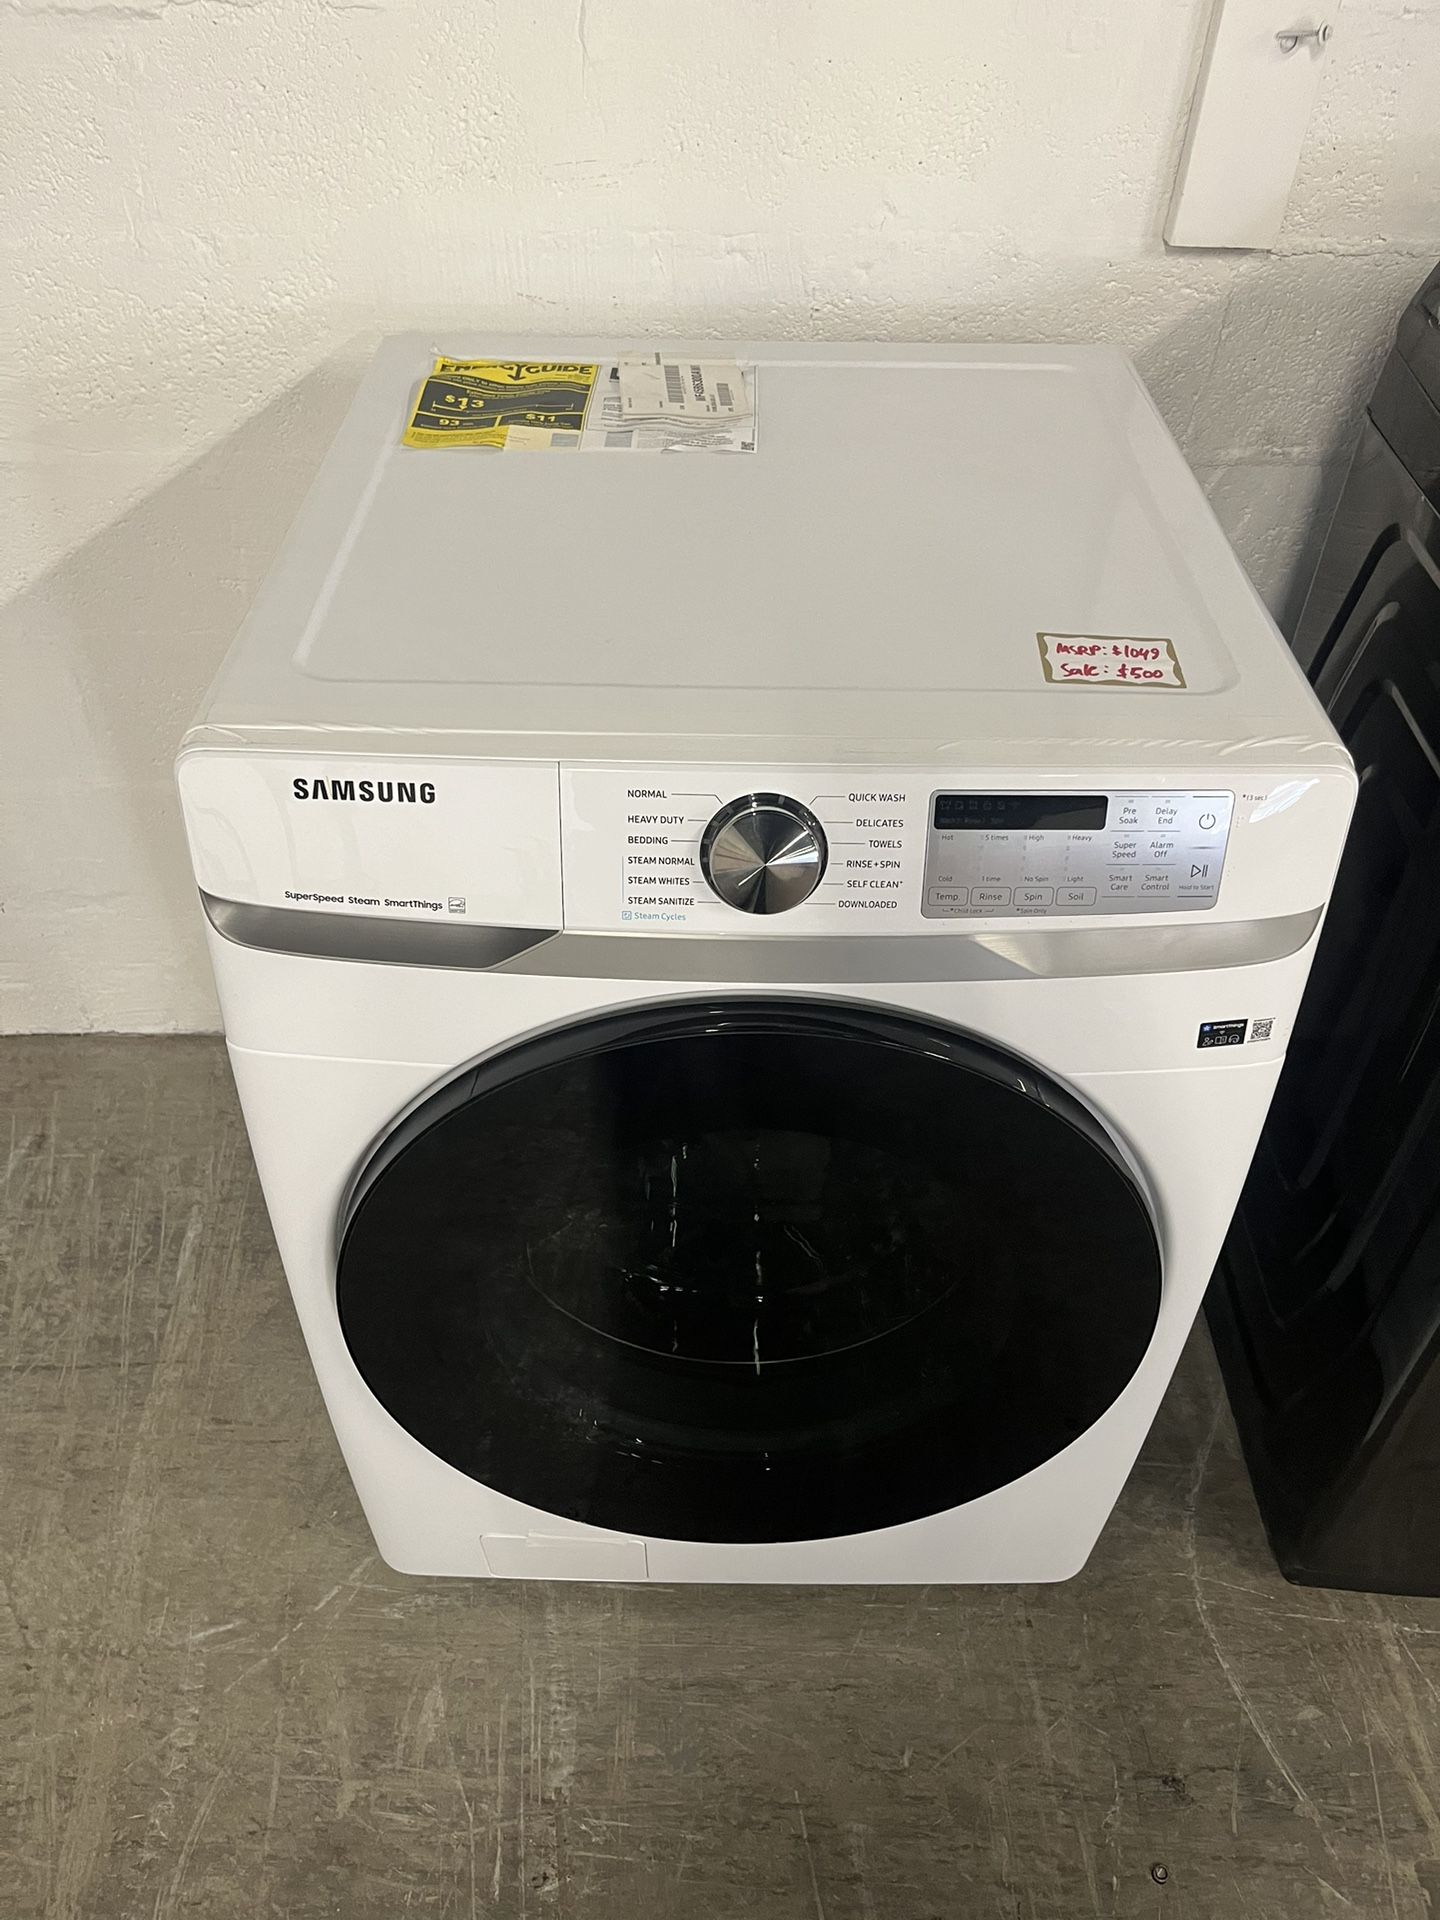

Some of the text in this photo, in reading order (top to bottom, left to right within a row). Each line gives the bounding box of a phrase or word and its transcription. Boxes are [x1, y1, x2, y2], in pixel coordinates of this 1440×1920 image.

[444, 395, 485, 411] $13
[439, 418, 460, 426] 93
[525, 413, 555, 422] $11
[1056, 643, 1160, 661] MSRP: $1049
[1116, 663, 1164, 679] $500
[293, 778, 436, 804] SAMSUNG
[627, 789, 668, 799] NORMAL
[848, 793, 906, 802] QUICK WASH
[1123, 807, 1137, 815] Pre
[1155, 807, 1178, 816] Delay
[627, 815, 684, 825] HEAVY DUTY
[855, 819, 904, 828] DELICATES
[1119, 817, 1138, 825] Soak
[1158, 817, 1173, 825] End
[627, 836, 669, 845] BEDDING
[1028, 834, 1045, 842] High
[1072, 834, 1093, 843] Heavy
[868, 840, 902, 849] TOWELS
[1114, 841, 1137, 850] Super
[1150, 841, 1174, 849] Alarm
[1112, 850, 1137, 859] Speed
[627, 856, 695, 866] STEAM NORMAL
[846, 860, 873, 869] RINSE
[880, 860, 901, 869] SPIN
[627, 876, 690, 886] STEAM WHITES
[1067, 875, 1084, 883] Light
[1108, 874, 1133, 882] Smart
[1145, 874, 1169, 882] Smart
[847, 880, 868, 888] SELF
[1141, 883, 1170, 891] Control
[284, 890, 443, 911] SuperSpeed Steam SmartThings
[627, 896, 695, 906] STEAM SANITIZE
[1024, 893, 1043, 902] Spin
[1068, 893, 1084, 901] Soil
[838, 900, 898, 909] DOWNLOADED
[634, 911, 686, 921] Steam Cycles
